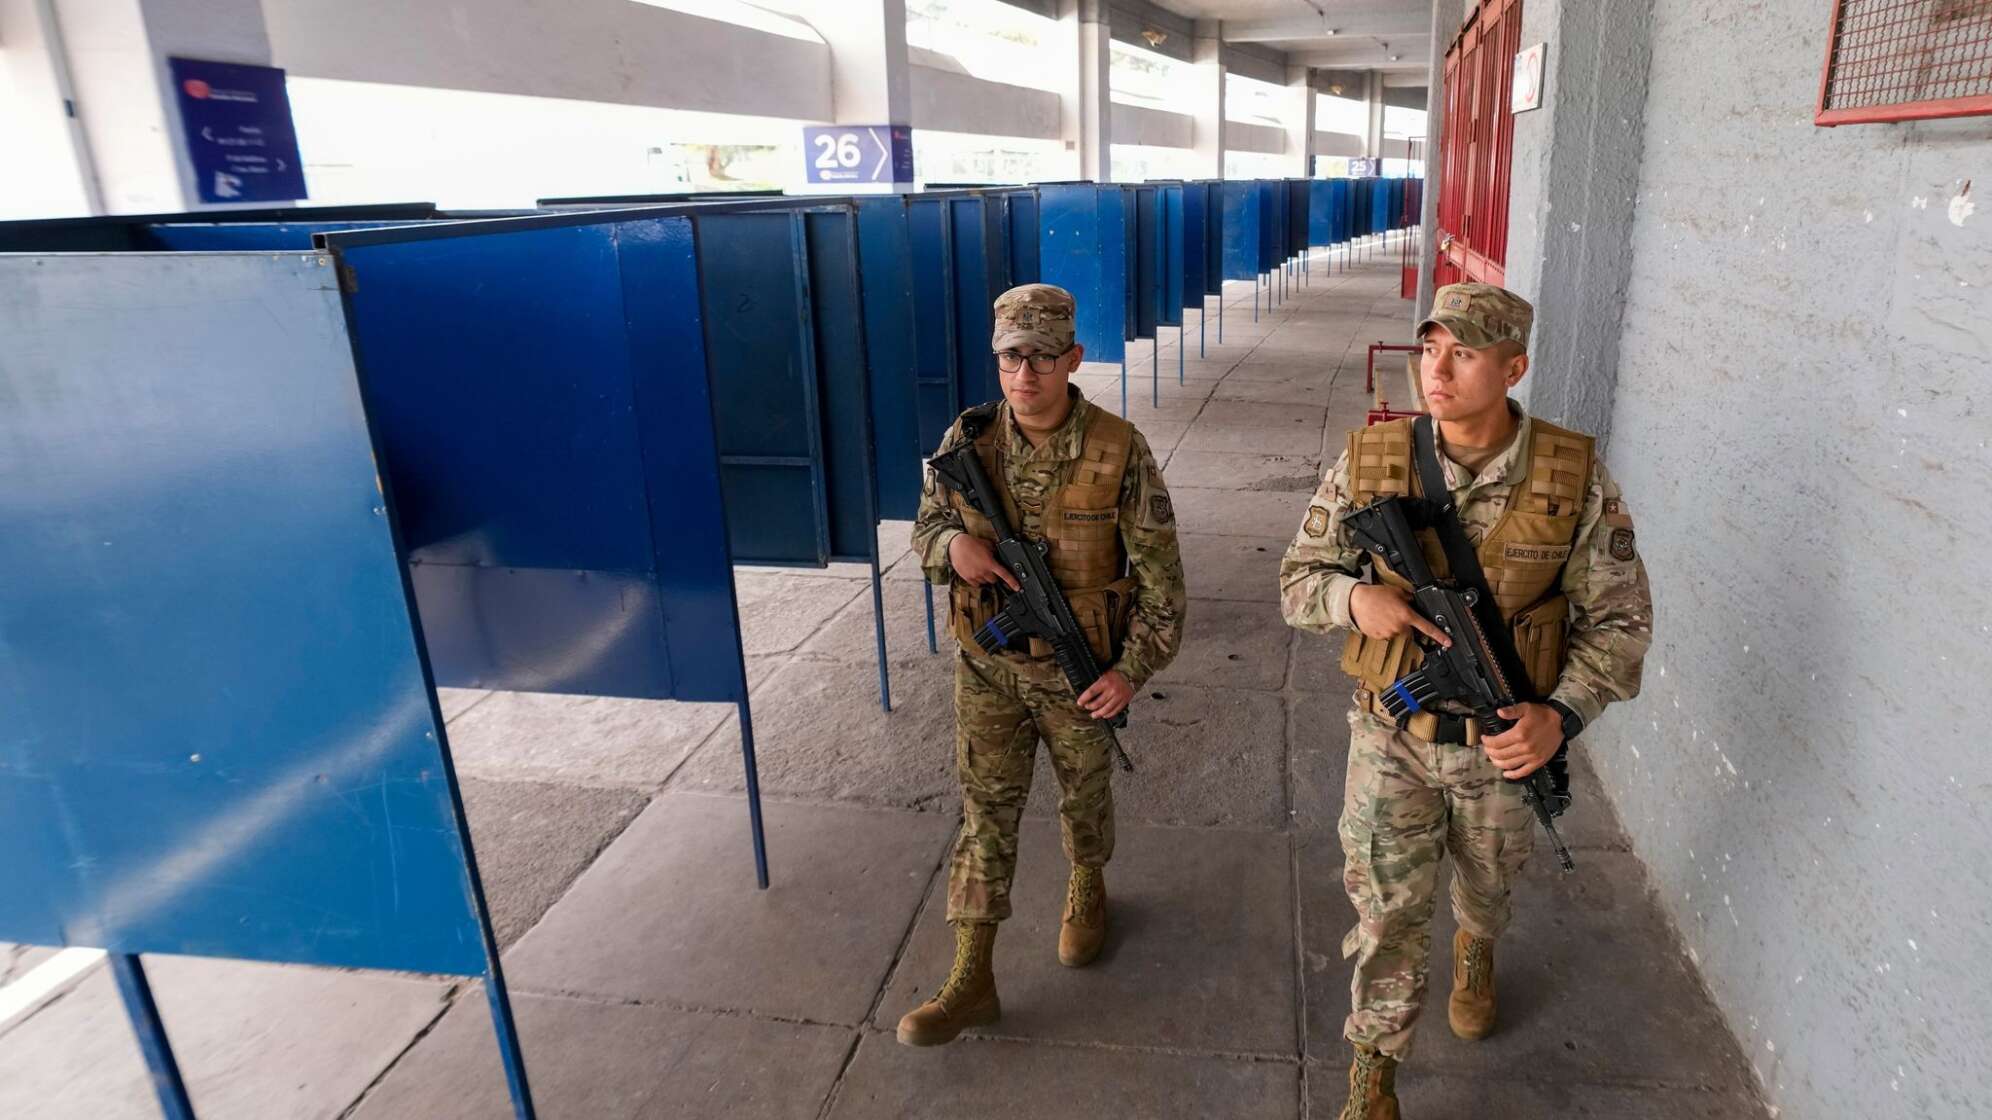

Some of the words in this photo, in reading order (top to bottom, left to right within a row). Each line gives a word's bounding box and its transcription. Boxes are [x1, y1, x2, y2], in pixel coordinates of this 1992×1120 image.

[814, 133, 861, 169] 26
[1351, 160, 1367, 172] 25
[1506, 547, 1539, 560] EJERCITO
[1541, 550, 1550, 560] DE
